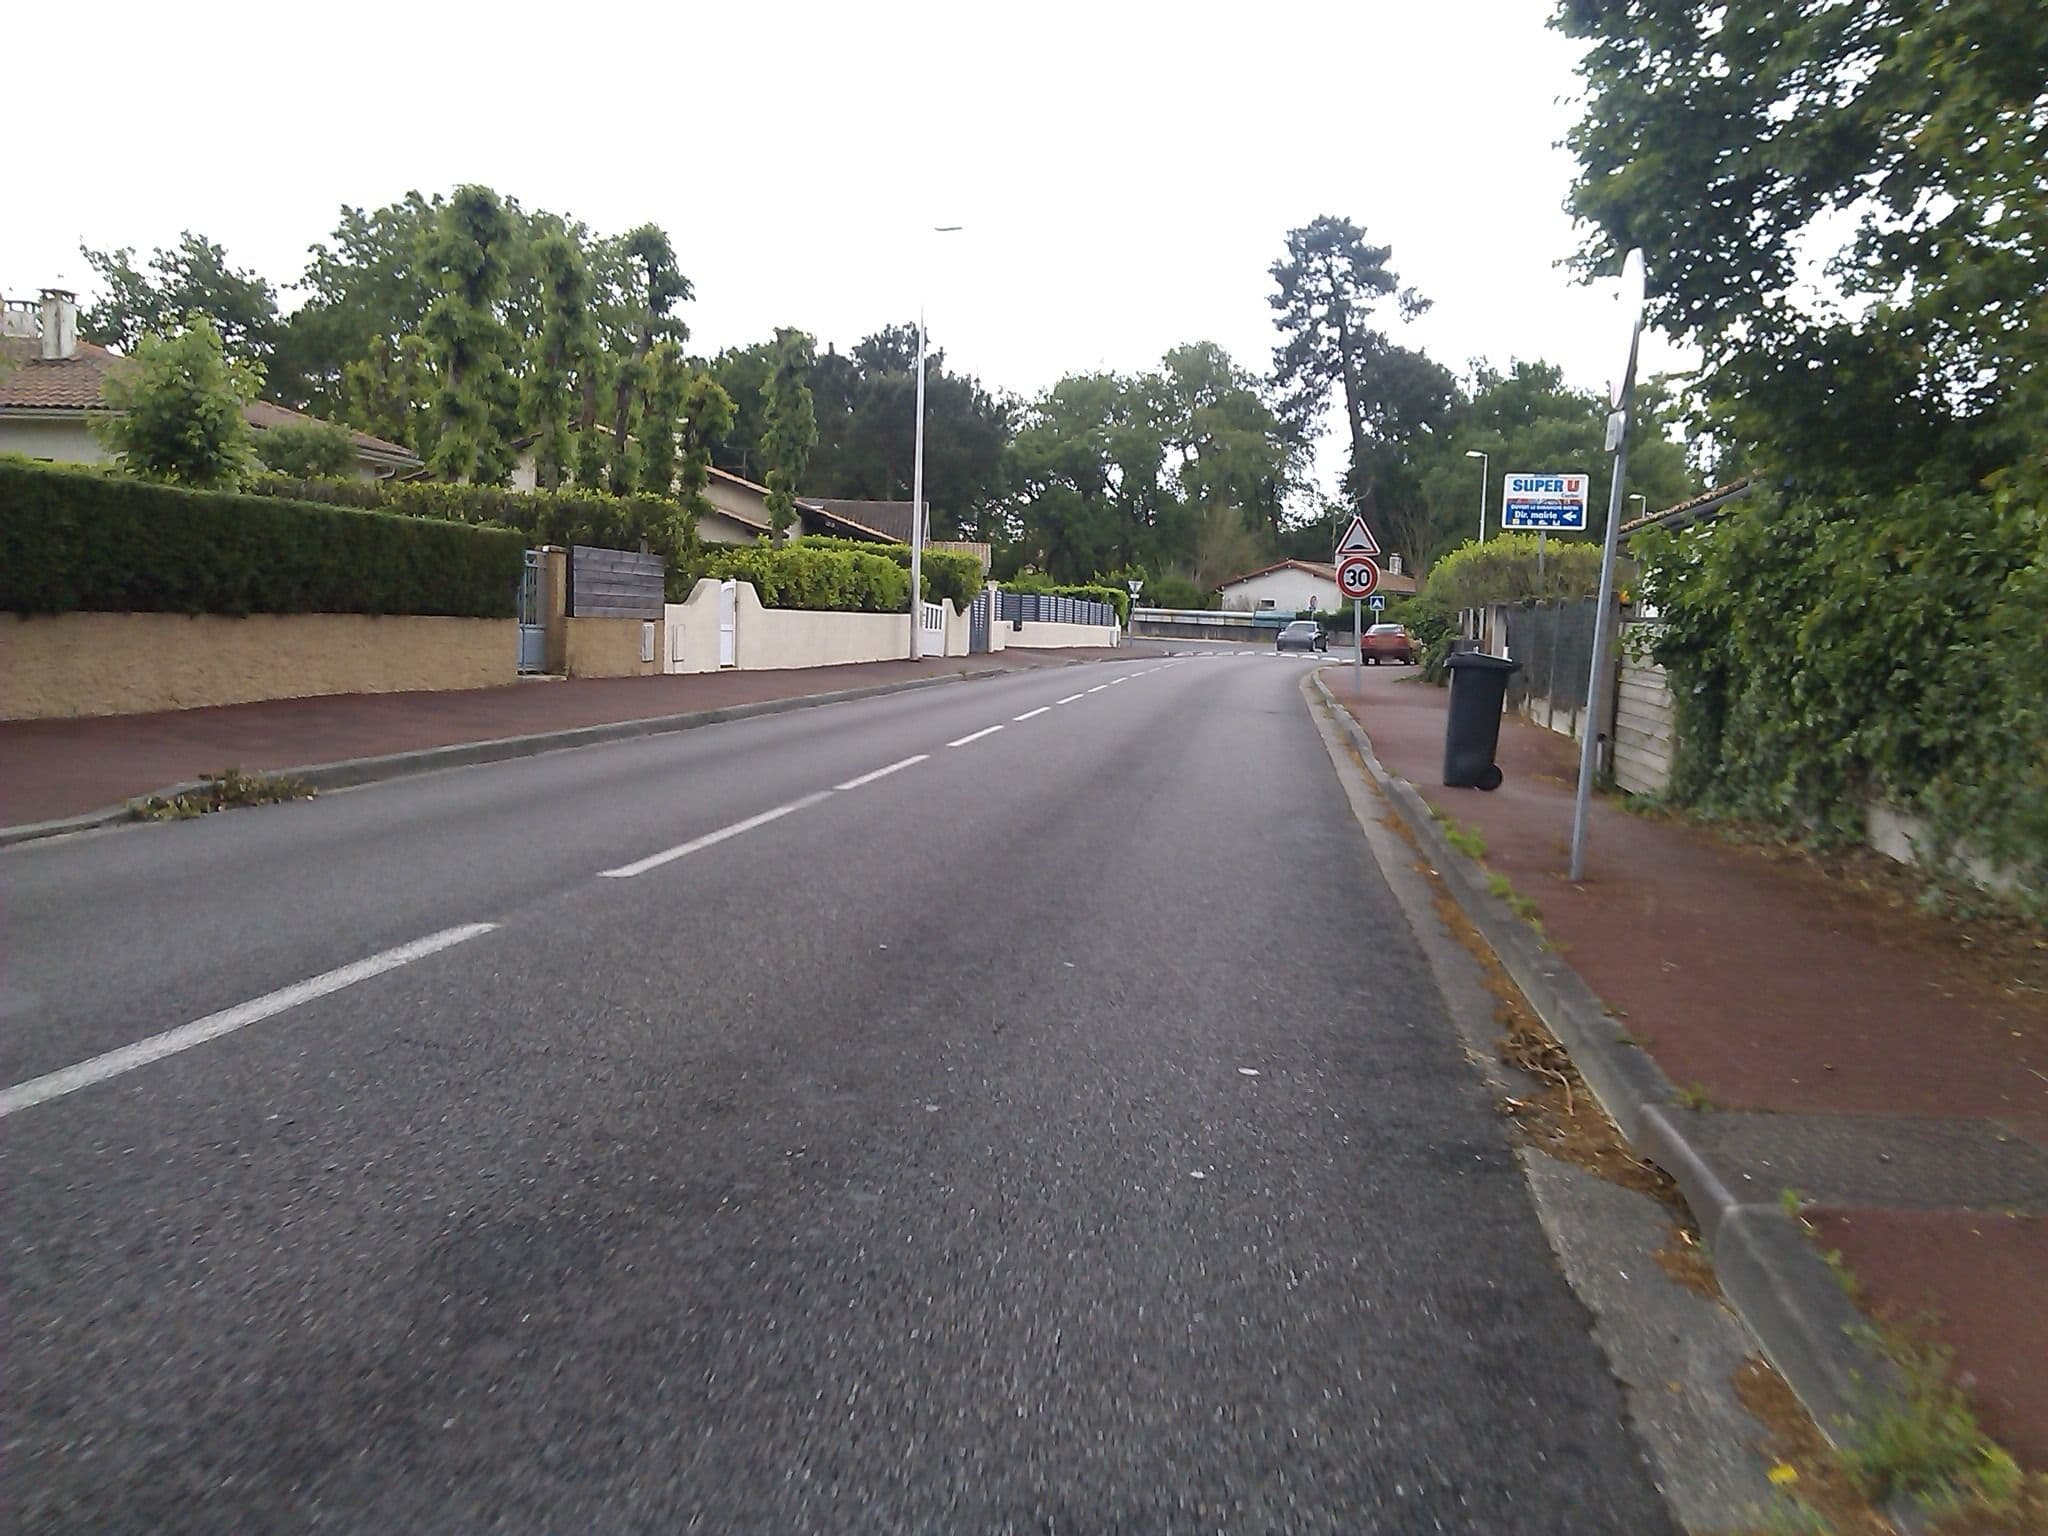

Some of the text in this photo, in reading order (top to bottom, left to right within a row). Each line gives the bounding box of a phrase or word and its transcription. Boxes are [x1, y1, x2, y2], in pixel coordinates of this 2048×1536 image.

[1512, 479, 1580, 492] SUPER U
[1514, 511, 1557, 519] Dir. mairie
[1345, 569, 1370, 586] 30
